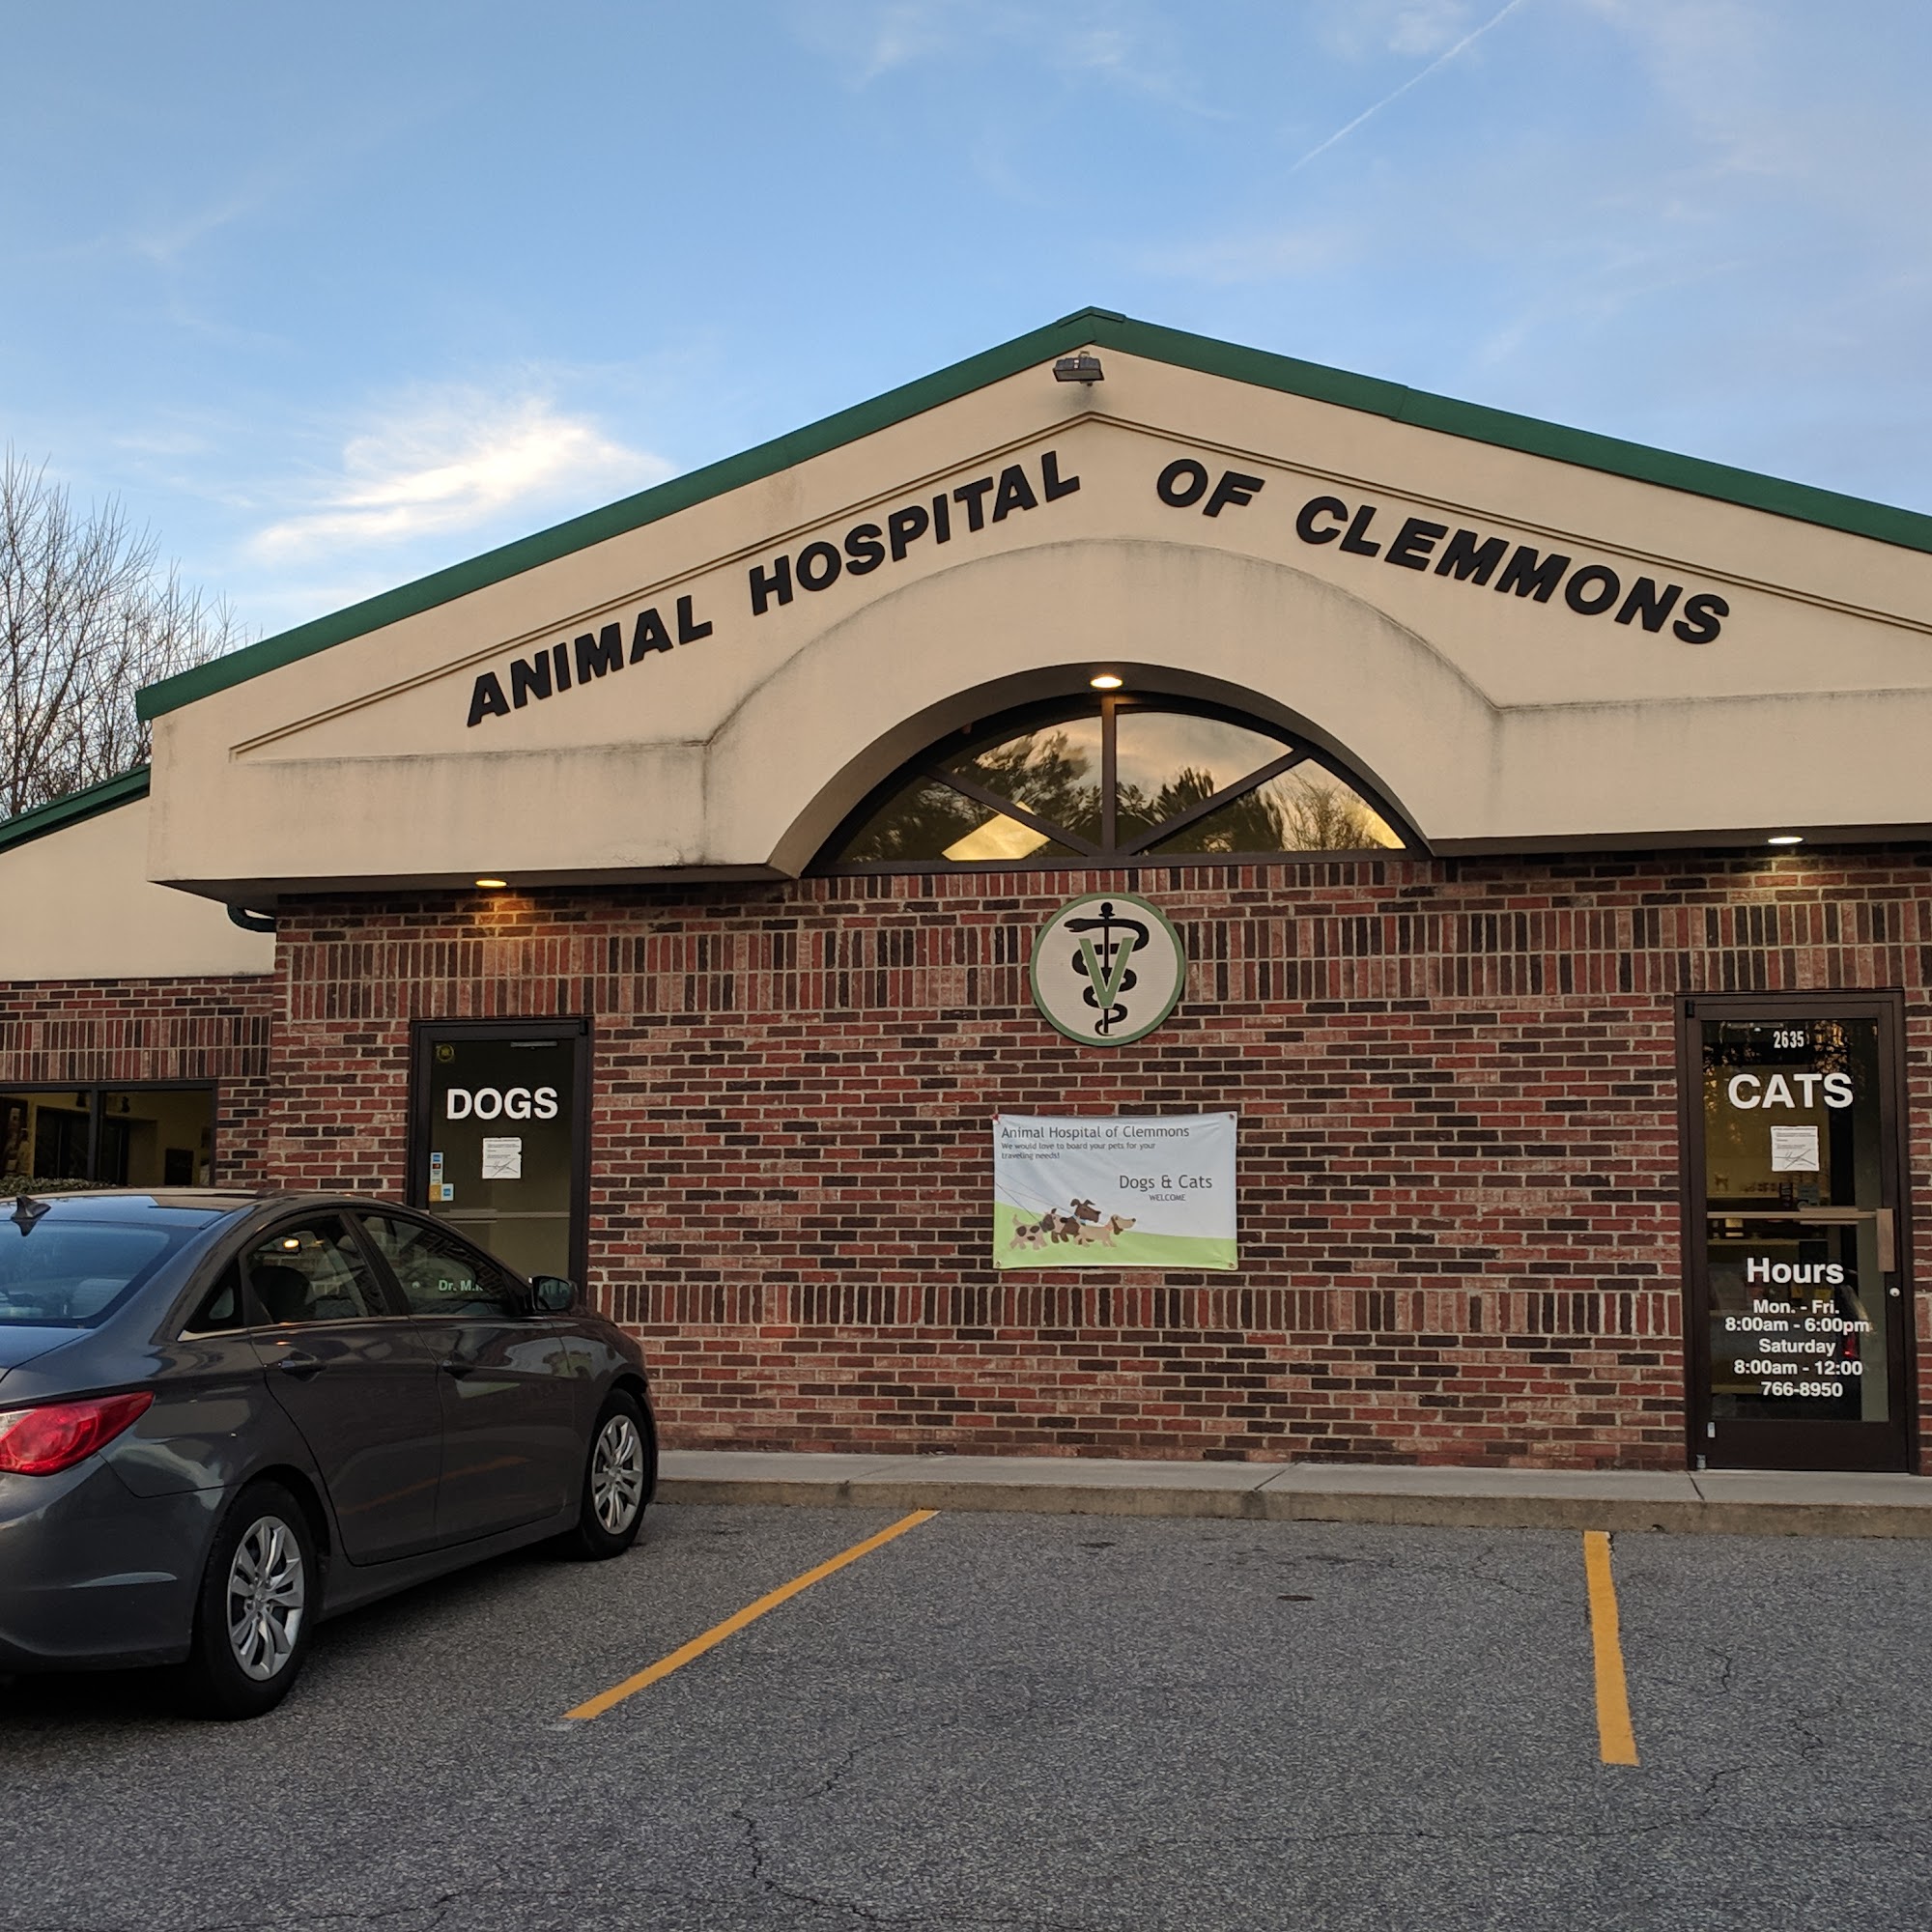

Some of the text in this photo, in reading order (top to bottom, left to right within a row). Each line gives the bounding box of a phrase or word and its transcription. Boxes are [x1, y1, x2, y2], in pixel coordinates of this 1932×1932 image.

[467, 450, 1730, 727] ANIMAL HOSPITAL OF CLEMMONS
[1773, 1030, 1804, 1049] 2635
[1727, 1072, 1854, 1110] CATS
[446, 1087, 558, 1120] DOGS
[1001, 1125, 1190, 1141] Animal Hospital of Clemmons
[1108, 1142, 1124, 1151] pets
[1119, 1174, 1213, 1192] Dogs & Cats
[1747, 1257, 1845, 1284] Hours
[438, 1279, 458, 1292] Dr.
[1753, 1299, 1796, 1314] Mon.
[1811, 1299, 1840, 1314] Fri.
[1724, 1317, 1789, 1332] 8:00am
[1804, 1318, 1870, 1335] 6:00pm
[1758, 1338, 1836, 1356] Saturday
[1733, 1359, 1798, 1376] 8:00am
[1814, 1360, 1863, 1376] 12:00
[1760, 1381, 1843, 1397] 766-8950
